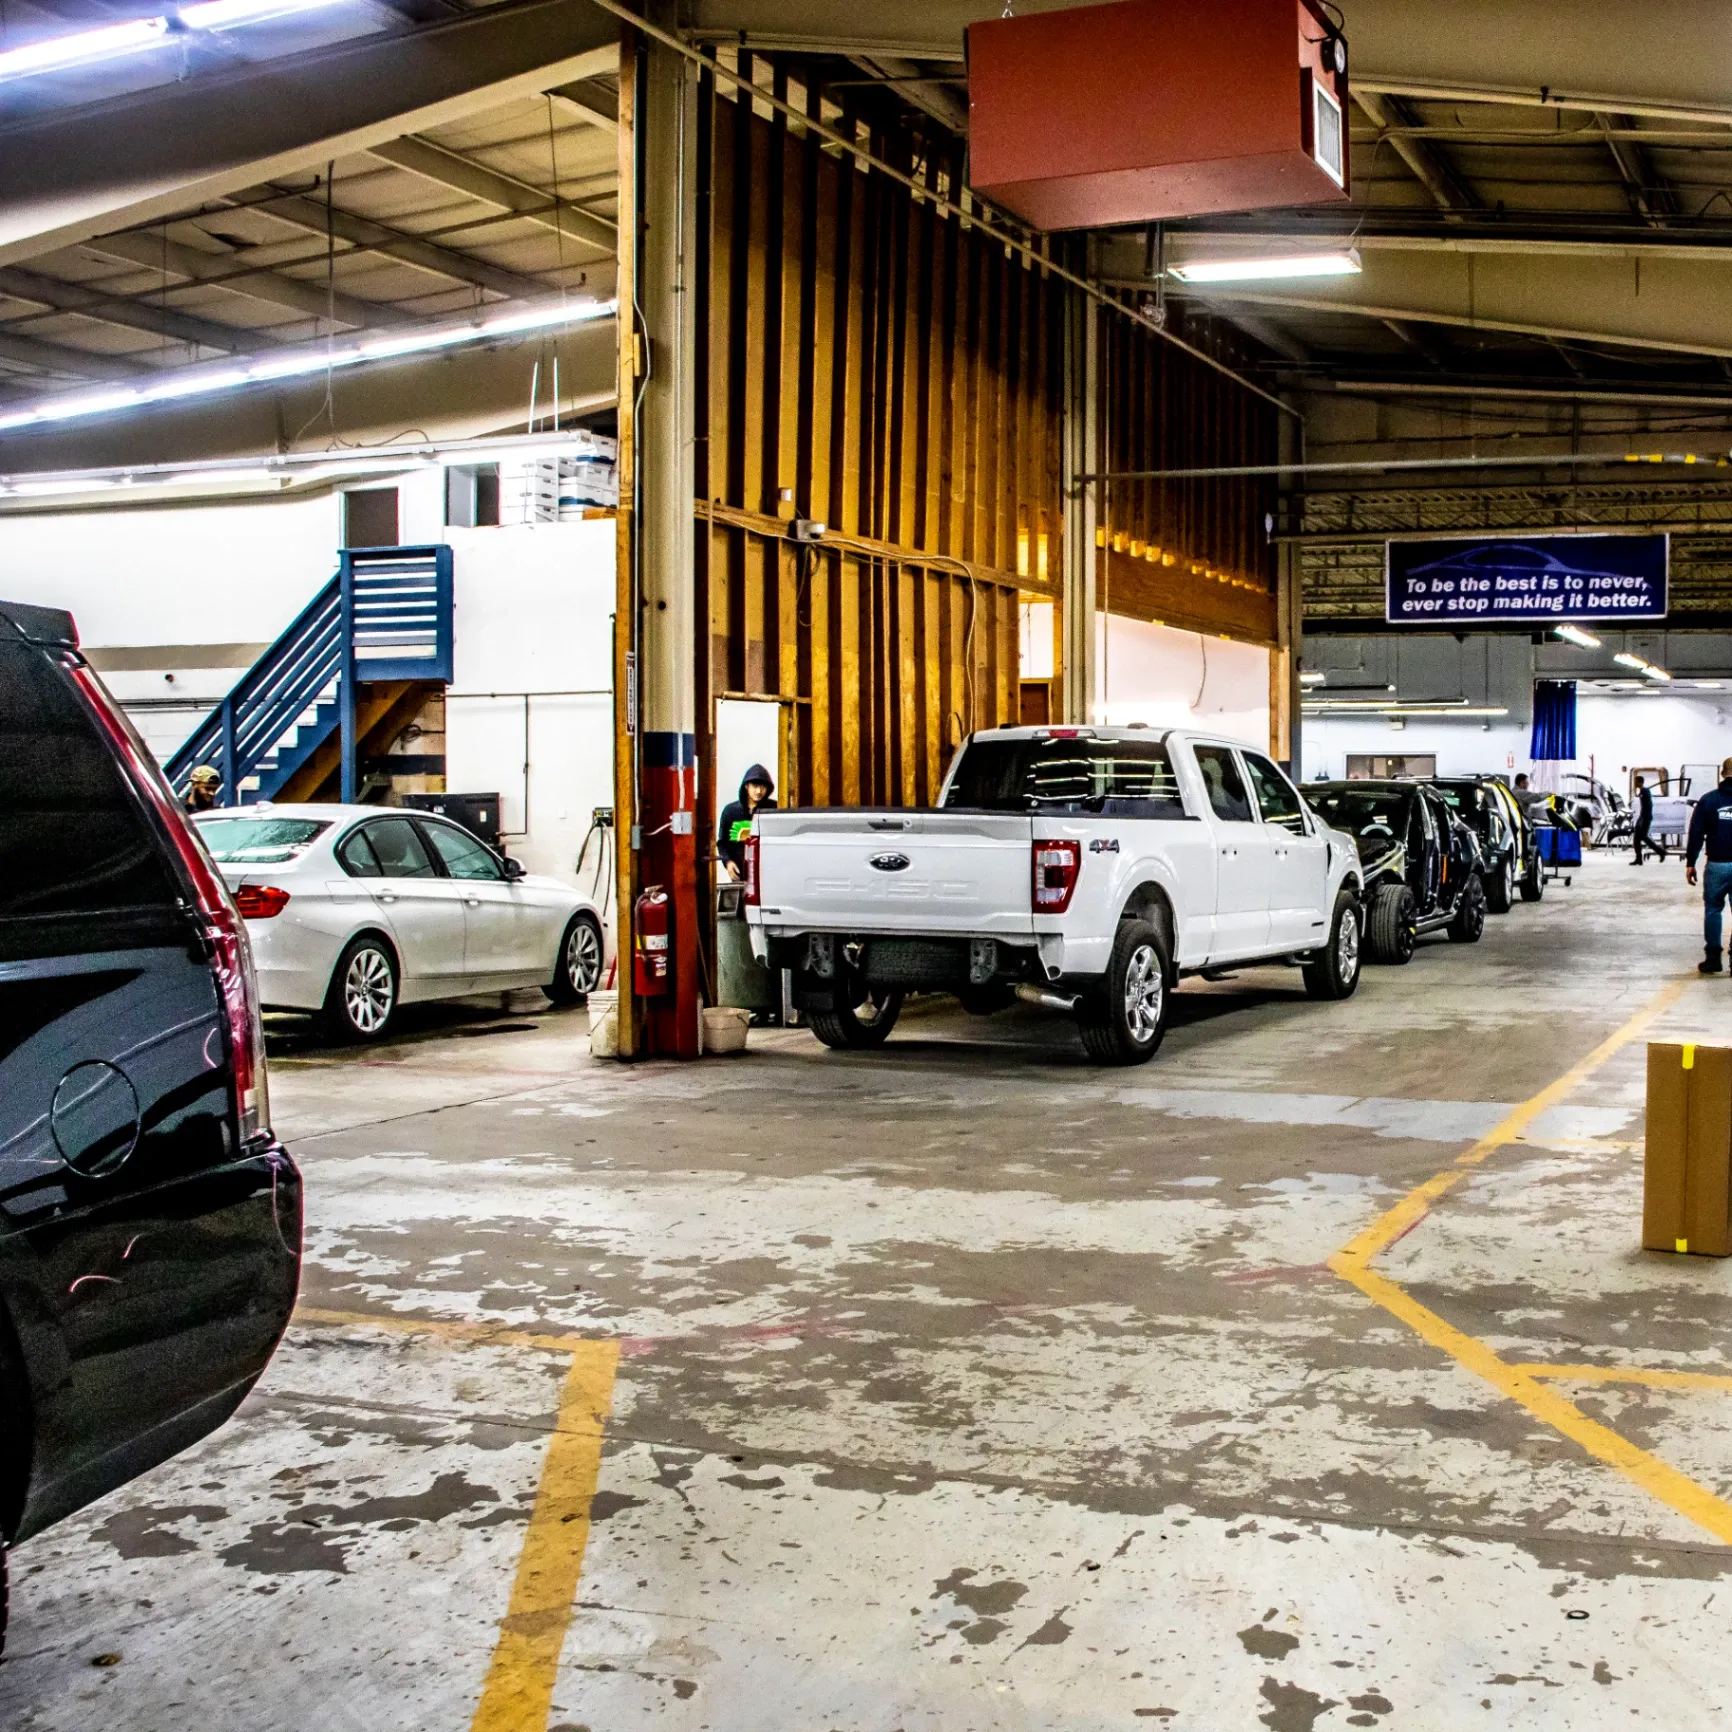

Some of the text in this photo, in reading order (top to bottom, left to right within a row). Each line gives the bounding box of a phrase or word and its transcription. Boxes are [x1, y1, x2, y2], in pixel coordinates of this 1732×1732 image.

[1406, 575, 1648, 593] To be the best is to never,
[1402, 592, 1652, 613] ever stop making it better.
